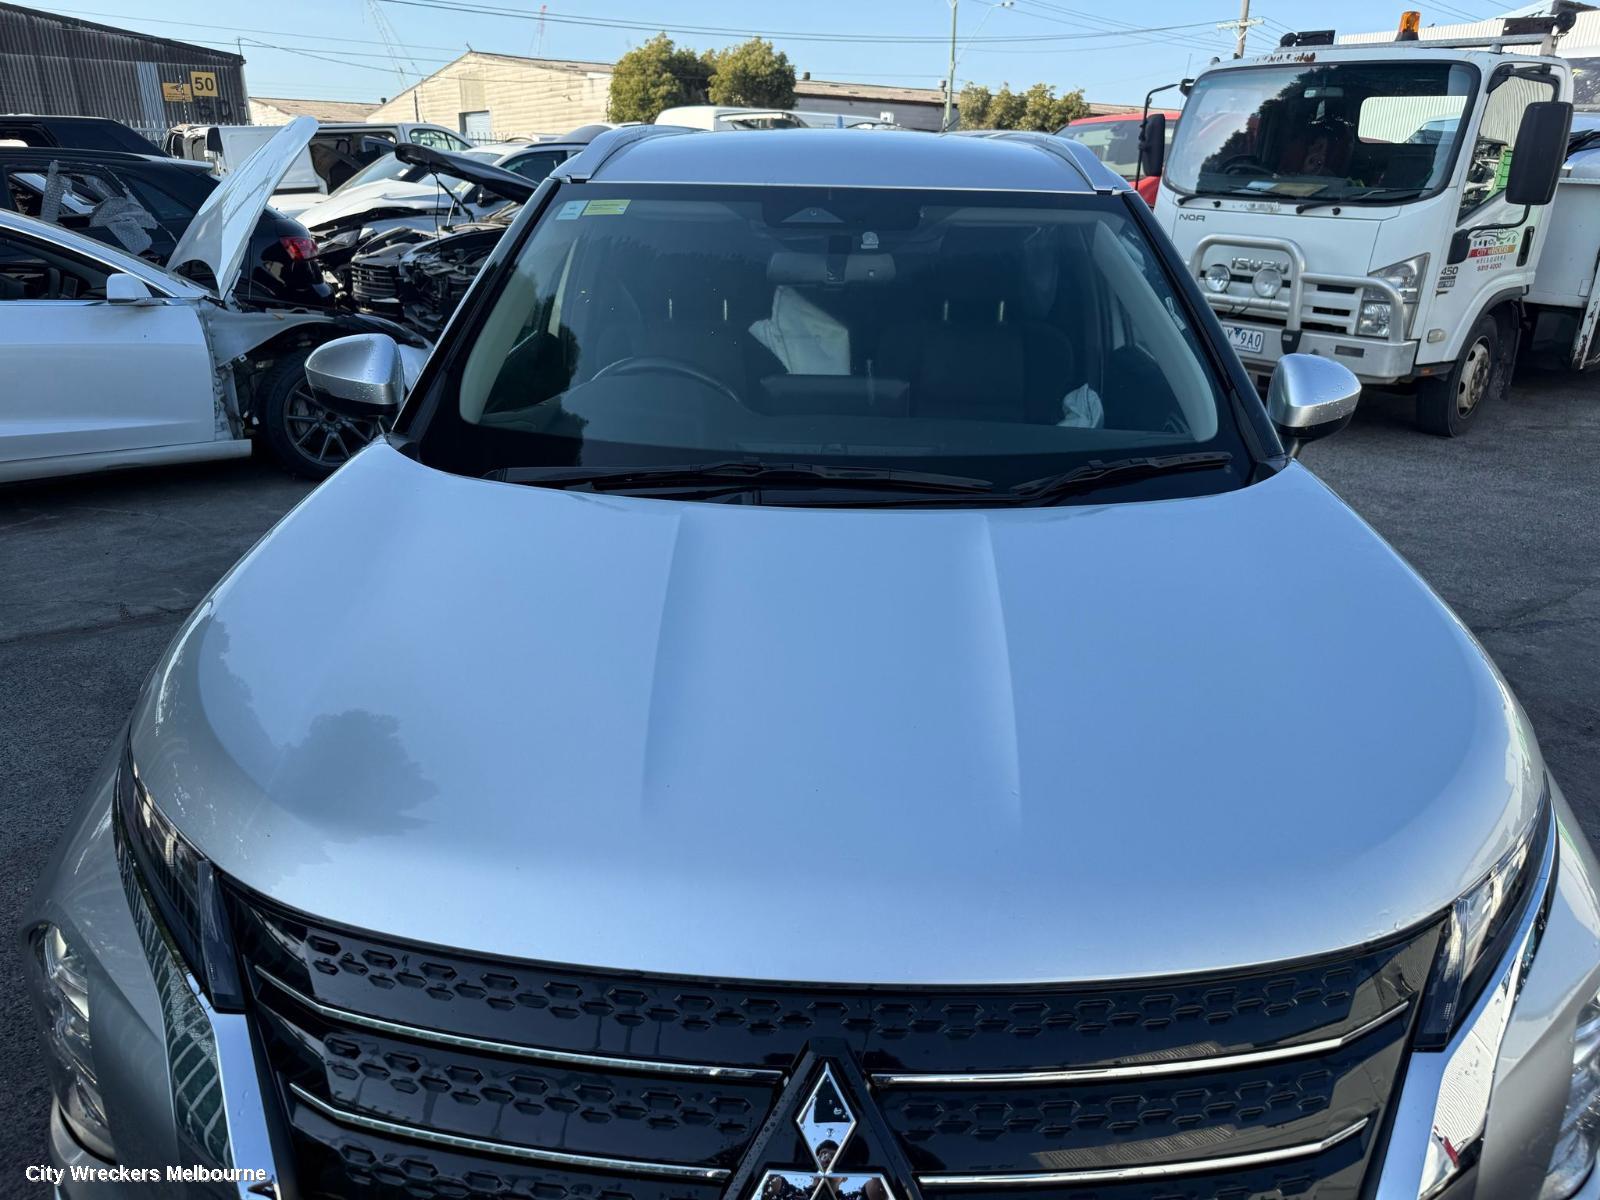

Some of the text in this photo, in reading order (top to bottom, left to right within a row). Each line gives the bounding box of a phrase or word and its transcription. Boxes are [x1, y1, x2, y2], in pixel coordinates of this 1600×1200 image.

[194, 77, 214, 91] 50
[1178, 213, 1206, 222] NQR
[1440, 266, 1459, 276] 450
